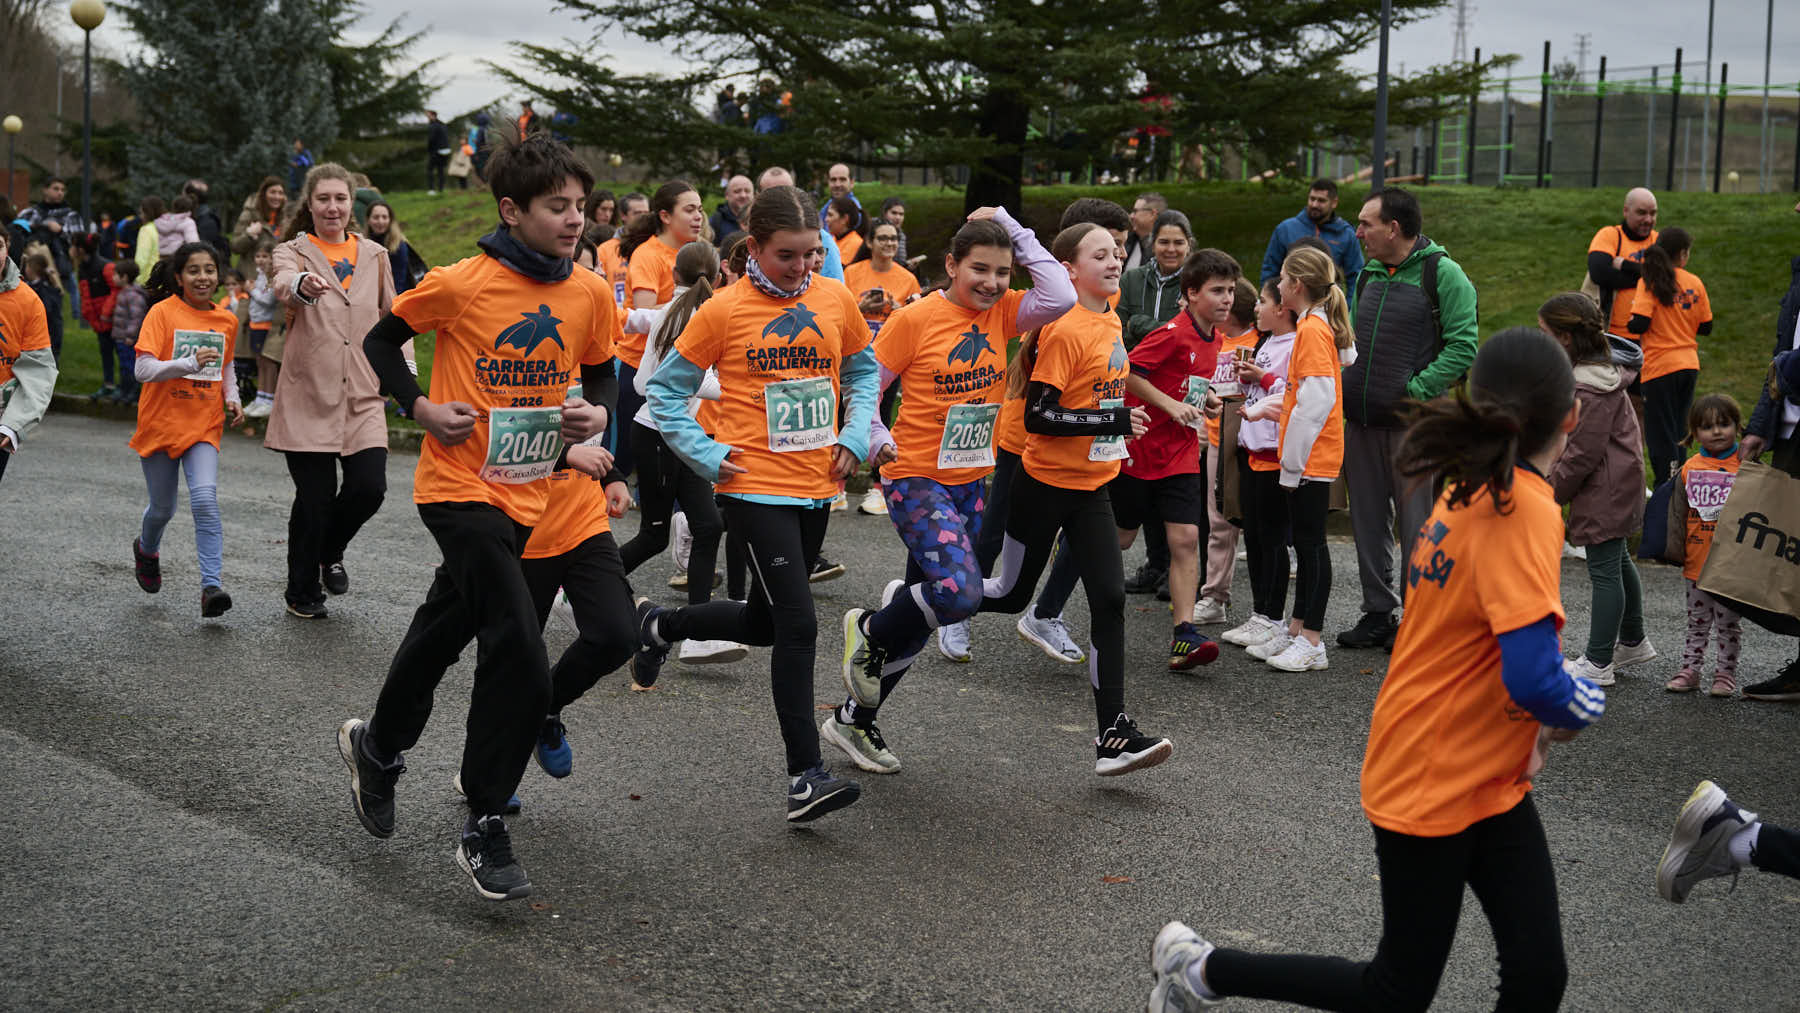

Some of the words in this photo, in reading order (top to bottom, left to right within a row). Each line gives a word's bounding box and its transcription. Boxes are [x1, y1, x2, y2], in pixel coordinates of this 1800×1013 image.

[745, 346, 818, 360] CARRERA
[475, 357, 557, 372] CARRERA
[758, 358, 832, 372] VALIENTES
[934, 364, 996, 385] CARRERA
[511, 396, 543, 407] 2026
[776, 396, 829, 431] 2110
[948, 421, 990, 449] 2036
[497, 430, 559, 464] 2040
